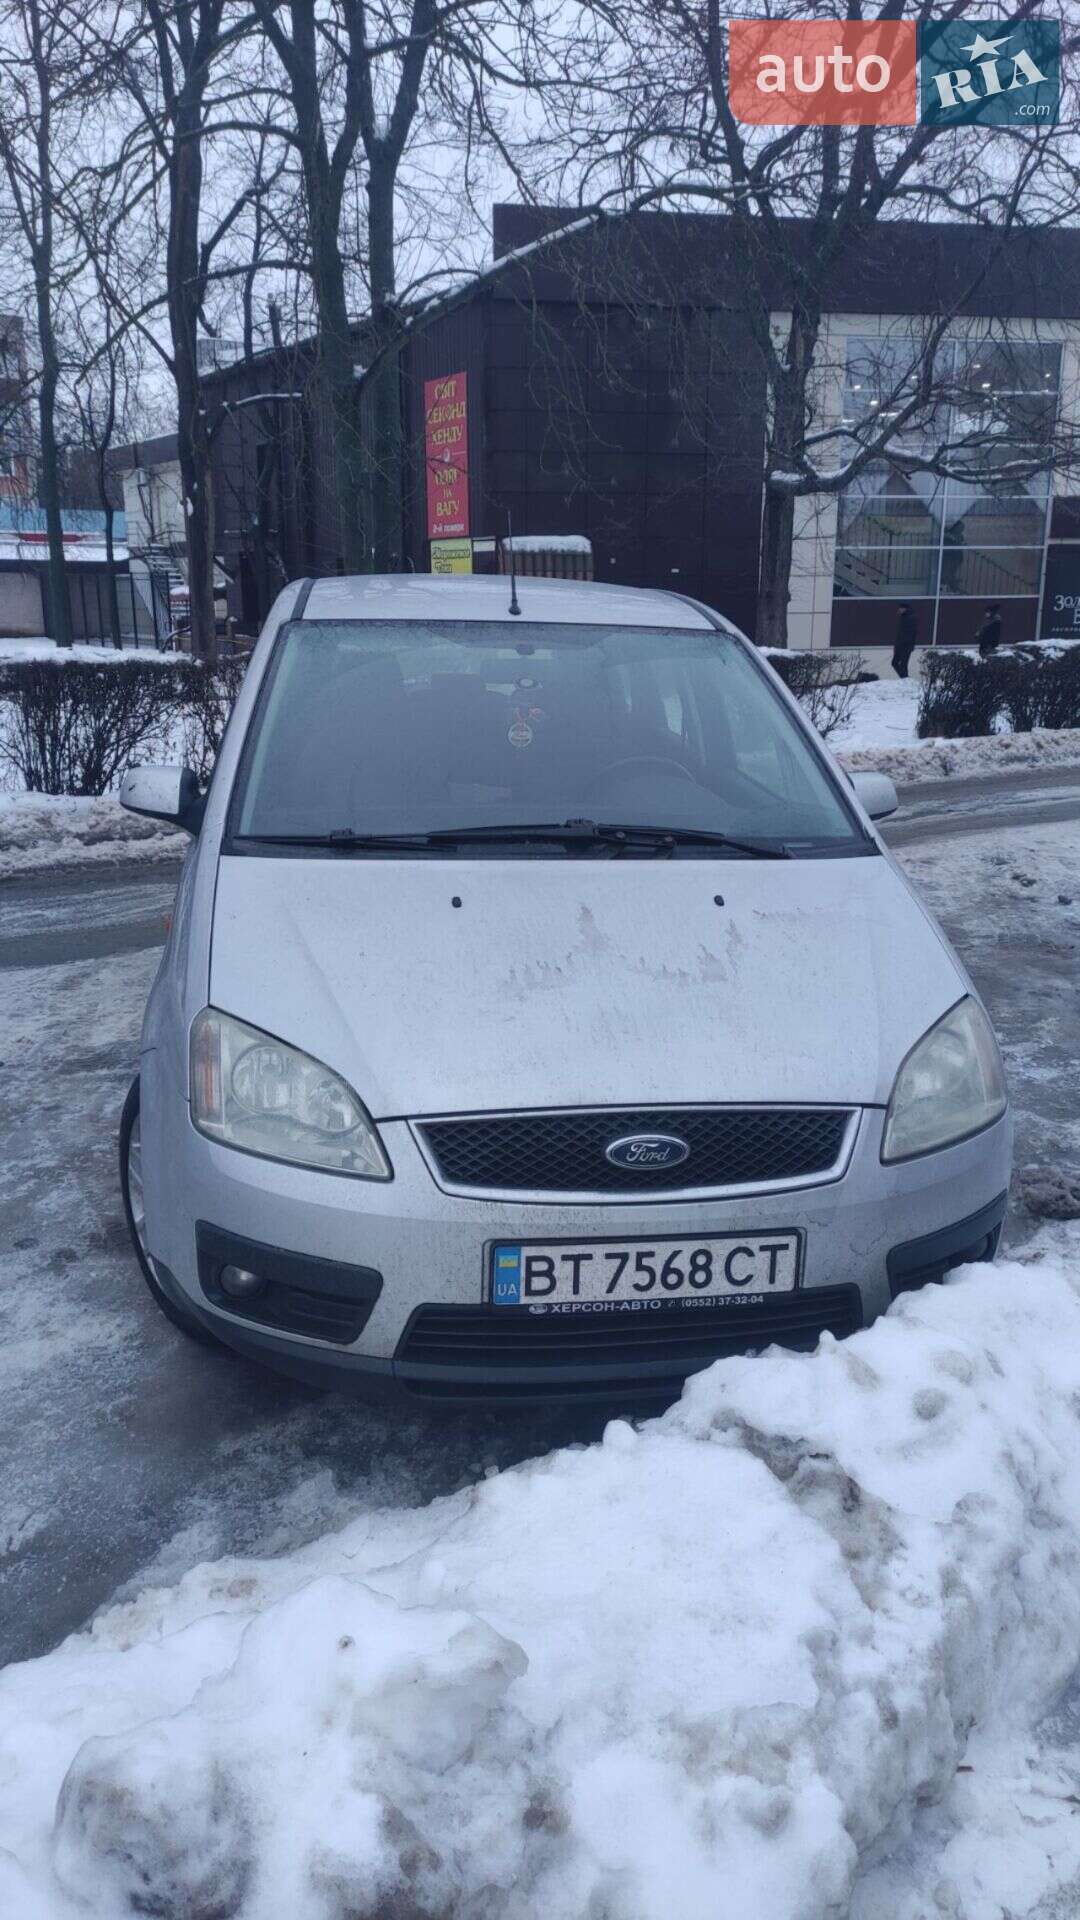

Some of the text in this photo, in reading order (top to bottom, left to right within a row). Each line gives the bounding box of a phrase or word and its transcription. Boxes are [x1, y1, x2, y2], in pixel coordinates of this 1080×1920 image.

[626, 1142, 671, 1161] Ford
[497, 1283, 519, 1297] UA
[604, 1248, 714, 1294] 7568
[551, 1295, 764, 1314] ХЕРСОН-АВТО (0552) 37-32-04
